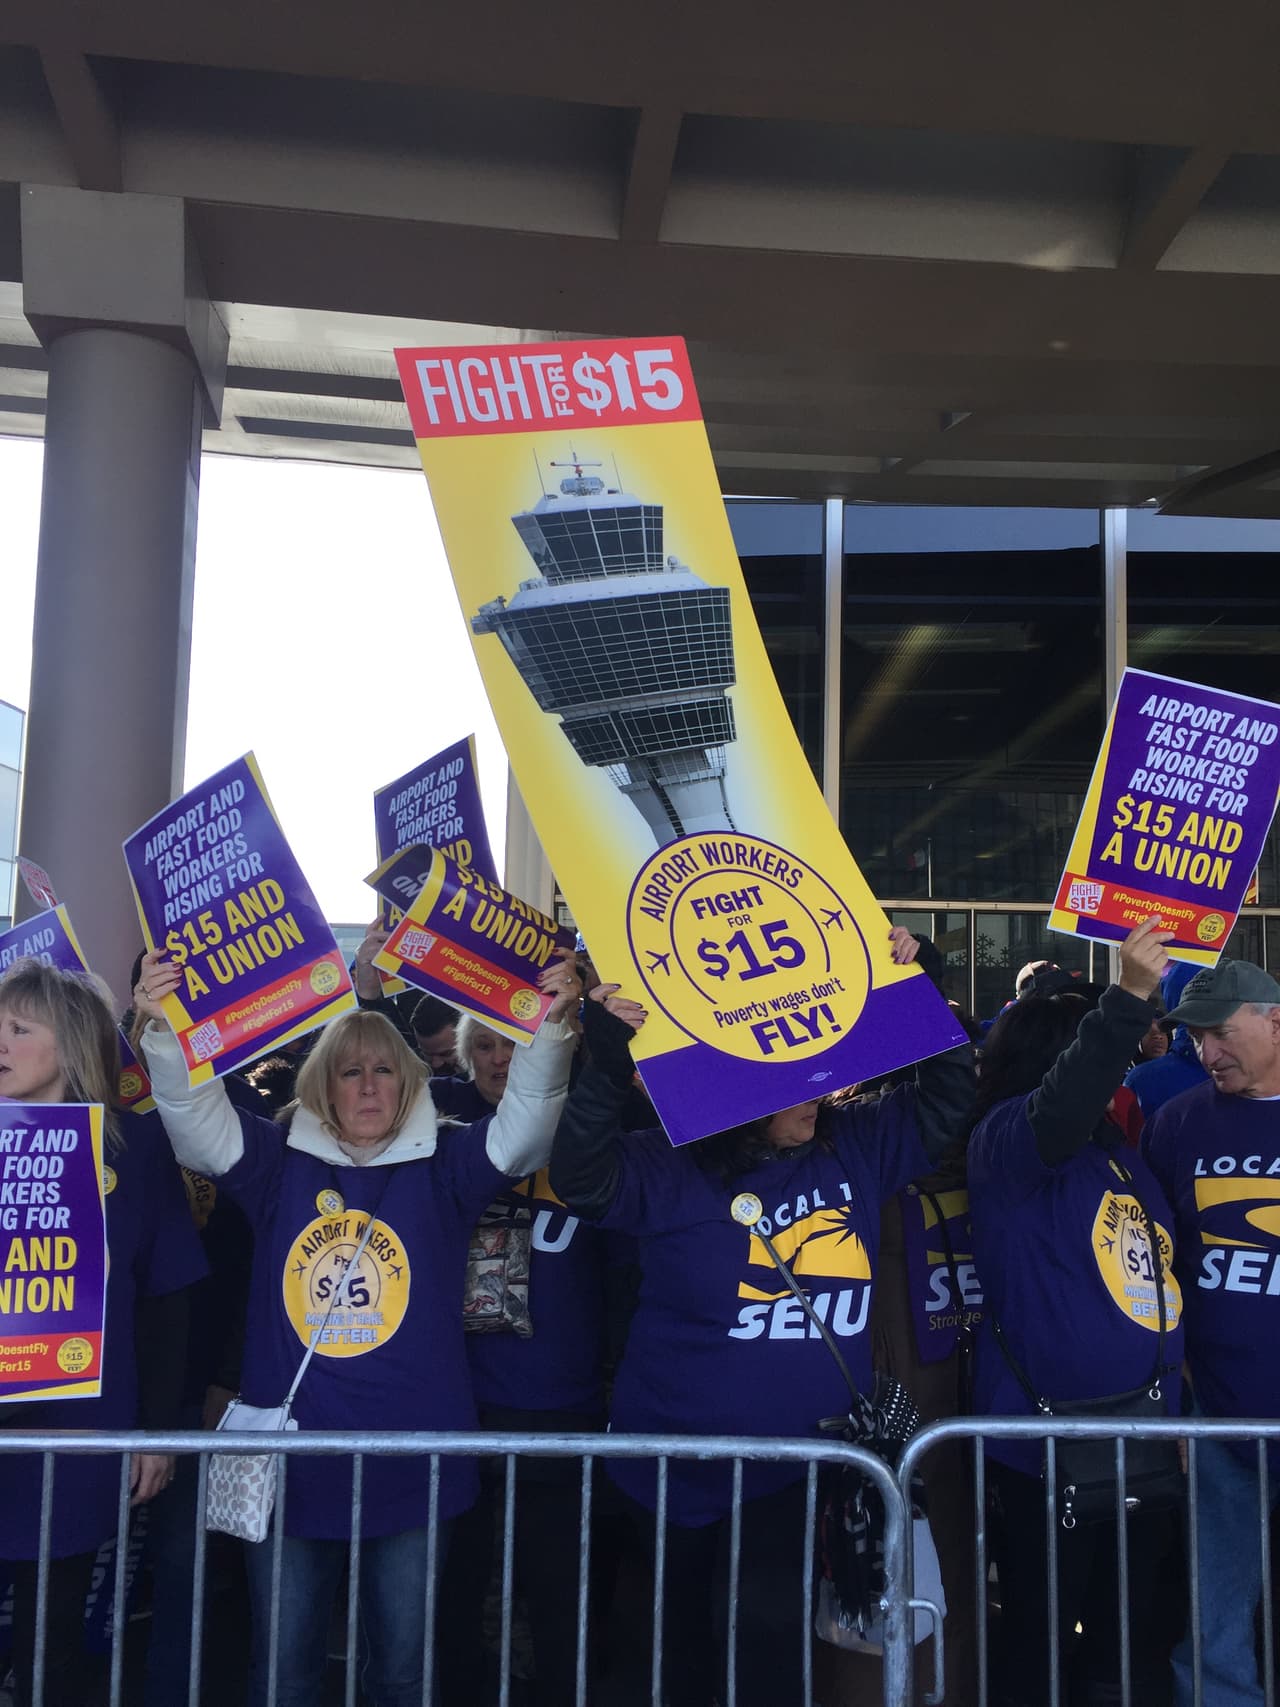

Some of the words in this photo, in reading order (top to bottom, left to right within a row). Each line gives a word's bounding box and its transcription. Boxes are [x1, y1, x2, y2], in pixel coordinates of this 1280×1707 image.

[415, 354, 563, 424] FIGHT
[547, 365, 575, 416] FOR
[572, 349, 684, 416] $15
[1139, 694, 1235, 734] AIRPORT
[1231, 717, 1279, 746] AND
[1146, 721, 1202, 752] FAST
[1201, 735, 1259, 767] FOOD
[388, 771, 437, 817] AIRPORT
[437, 756, 465, 785] AND
[1128, 768, 1204, 806] RISING
[1205, 788, 1249, 817] FOR
[1145, 746, 1249, 791] WORKERS
[145, 801, 205, 865] AIRPORT
[210, 779, 245, 818] AND
[395, 799, 422, 830] FAST
[424, 780, 457, 812] FOOD
[397, 799, 457, 846] WORKERS
[1112, 793, 1176, 838] $15
[1177, 811, 1244, 855] AND
[156, 836, 192, 880] FAST
[196, 808, 242, 852] FOOD
[437, 816, 464, 844] FOR
[163, 832, 248, 899] WORKERS
[639, 846, 700, 923] AIRPORT
[698, 841, 804, 889] WORKERS
[1100, 831, 1123, 865] A
[1134, 838, 1233, 890] UNION
[164, 874, 224, 927] RISING
[226, 851, 265, 889] FOR
[456, 862, 504, 904] $15
[510, 895, 559, 935] AND
[690, 885, 765, 920] FIGHT
[1071, 884, 1096, 896] FIGHT
[1112, 890, 1196, 922] #PovertyDoesntFly
[23, 927, 56, 957] AND
[165, 910, 223, 965] $15
[224, 878, 285, 935] AND
[442, 887, 468, 922] A
[470, 900, 556, 969] UNION
[727, 914, 753, 928] FOR
[184, 965, 210, 1001] A
[206, 912, 305, 985] UNION
[440, 946, 511, 991] #PovertyDoesntFly
[697, 919, 806, 982] $15
[224, 978, 303, 1025] #PovertyDoesntFly
[442, 964, 493, 996] #FightFor15
[713, 1002, 769, 1028] Poverty
[771, 991, 811, 1010] wages
[811, 976, 846, 1001] don't
[242, 999, 295, 1032] #FightFor15
[750, 1002, 843, 1056] FLY!
[28, 1128, 79, 1153] AND
[3, 1155, 65, 1180] FOOD
[0, 1181, 61, 1205] KERS
[25, 1206, 71, 1230] FOR
[355, 1221, 397, 1262] WKERS
[4, 1236, 78, 1273] AND
[1127, 1247, 1156, 1282] $1
[728, 1285, 872, 1340] SEIU
